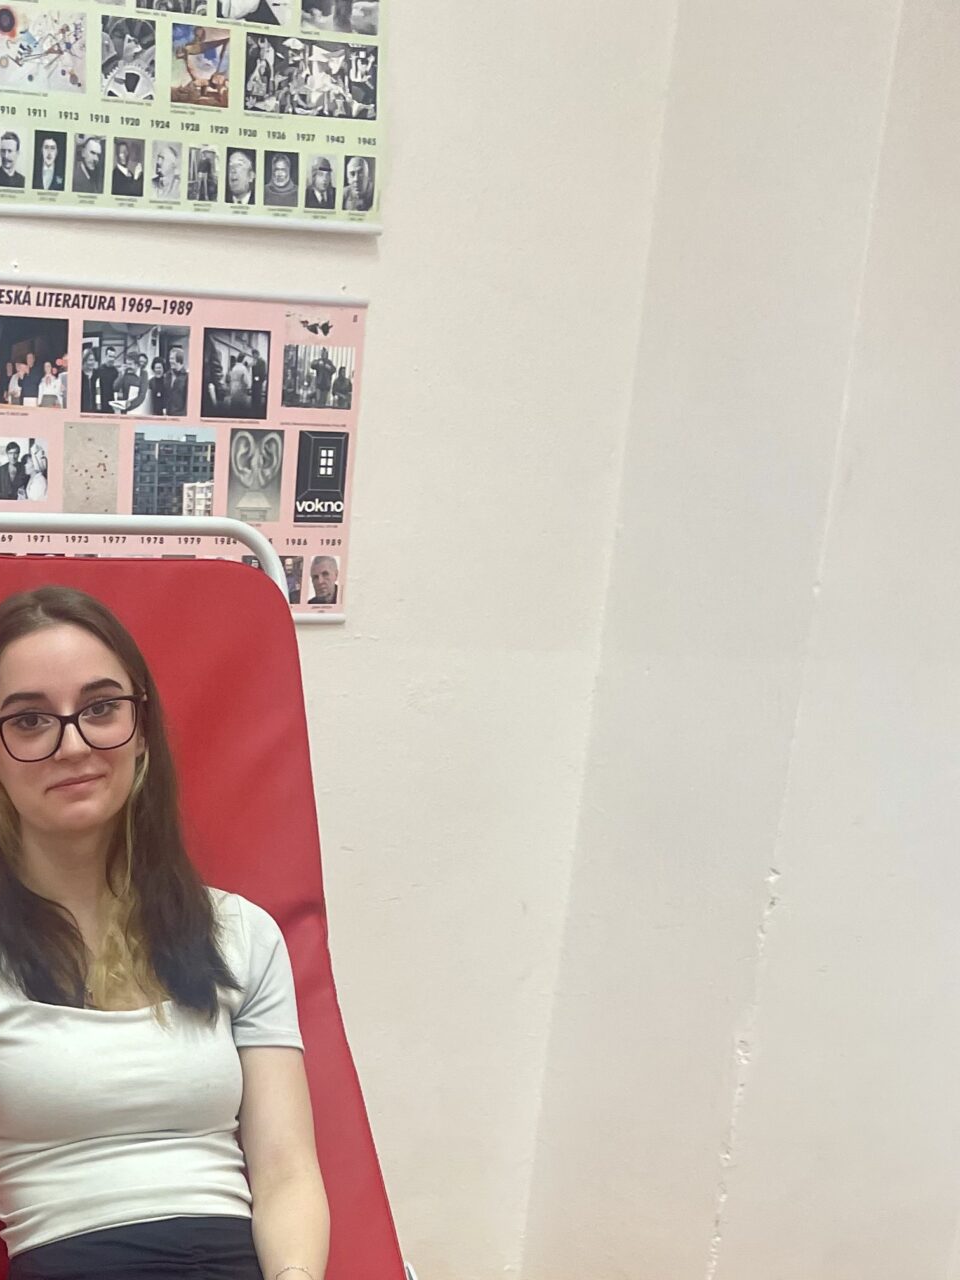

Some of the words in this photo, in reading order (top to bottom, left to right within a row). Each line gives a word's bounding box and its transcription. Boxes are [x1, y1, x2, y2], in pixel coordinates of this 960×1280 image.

[36, 291, 116, 312] LITERATURA
[296, 498, 344, 513] vokno
[27, 534, 51, 543] 1971
[65, 535, 89, 543] 1973
[103, 536, 127, 544] 1977
[178, 537, 201, 545] 1979
